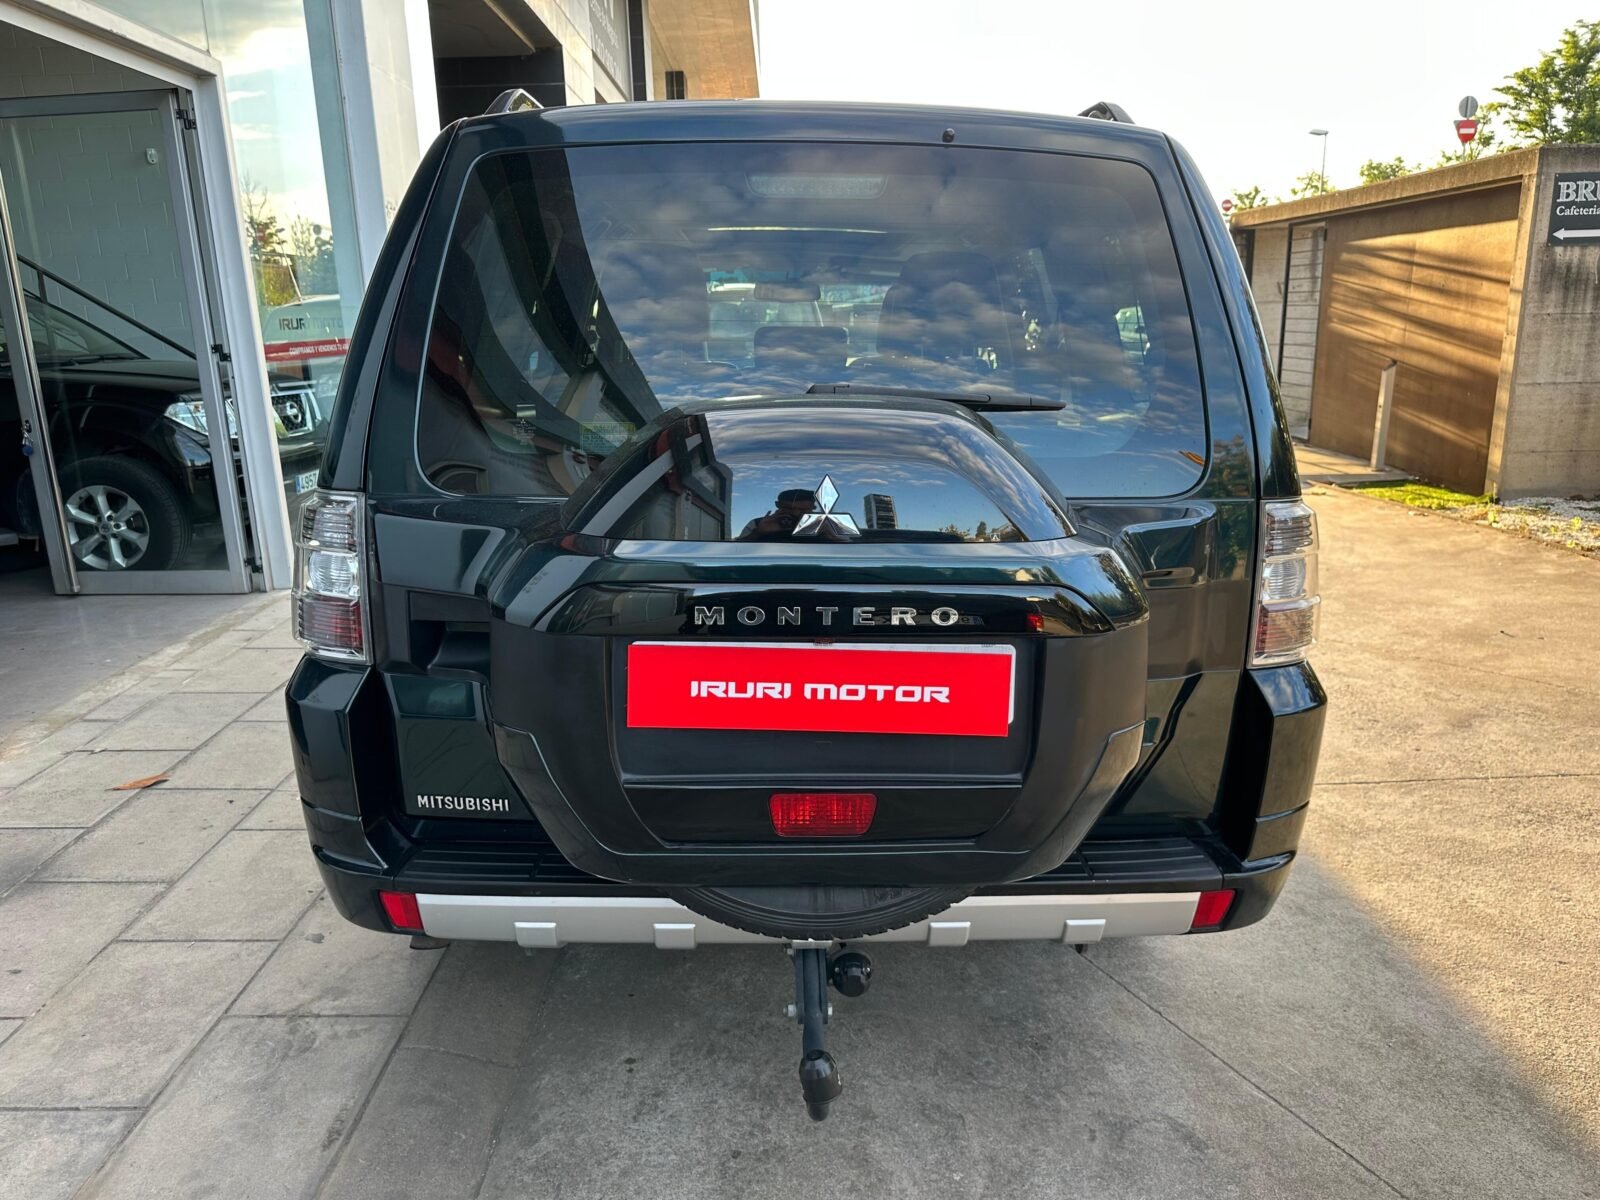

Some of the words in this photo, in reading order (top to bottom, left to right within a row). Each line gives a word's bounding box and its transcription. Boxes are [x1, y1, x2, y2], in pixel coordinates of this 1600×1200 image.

[694, 606, 959, 626] MONTERO
[690, 680, 792, 699] IRURI
[804, 683, 950, 704] MOTOR
[417, 794, 510, 812] MITSUBISHI
